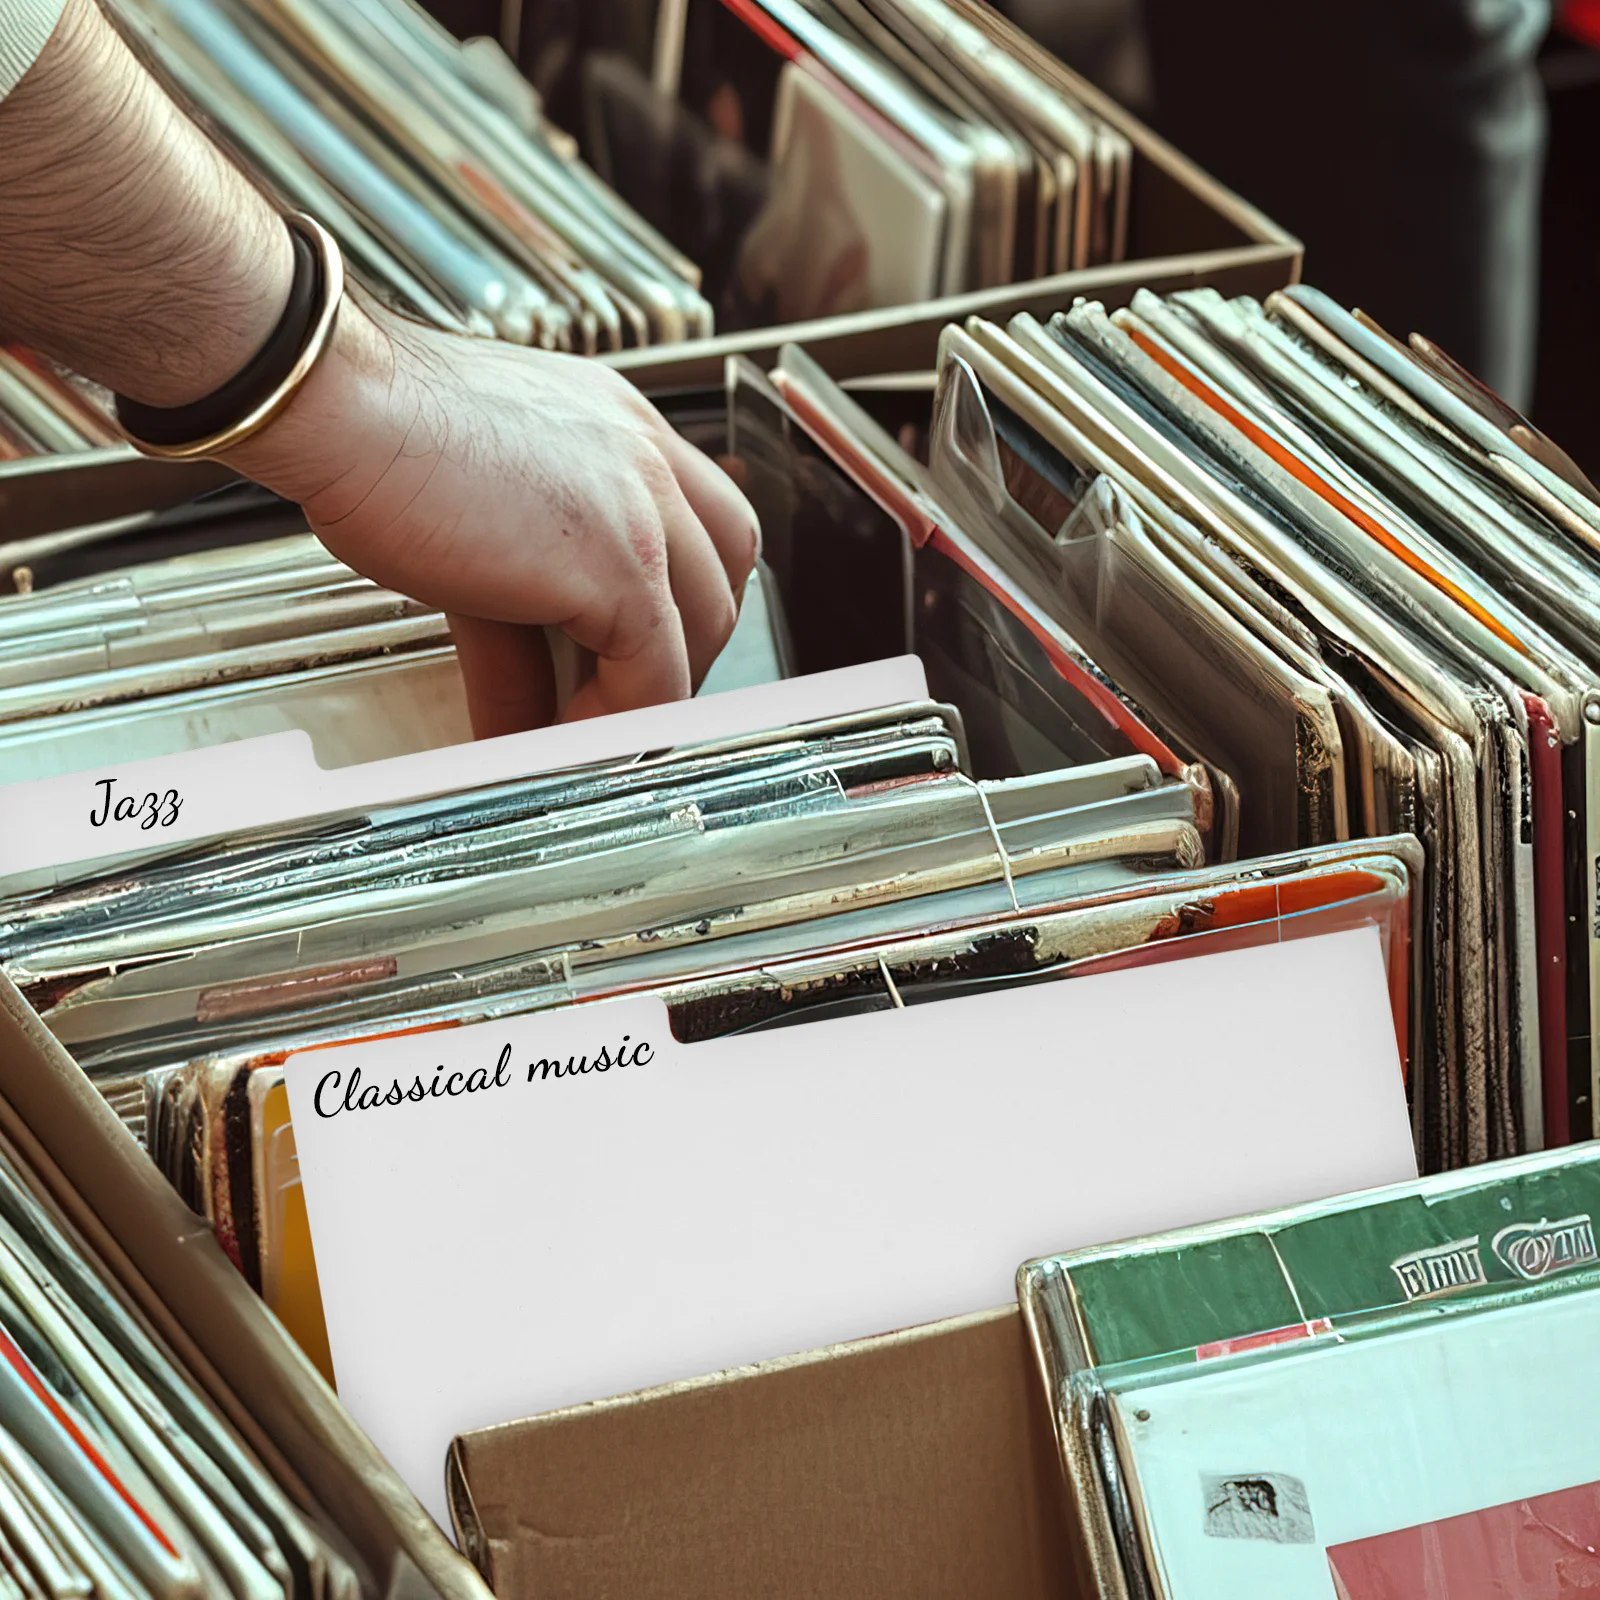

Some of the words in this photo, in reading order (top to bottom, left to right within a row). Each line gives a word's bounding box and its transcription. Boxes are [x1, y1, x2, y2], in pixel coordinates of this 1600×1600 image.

[90, 778, 184, 831] Jazz
[313, 1042, 512, 1119] Classical
[526, 1034, 656, 1084] music
